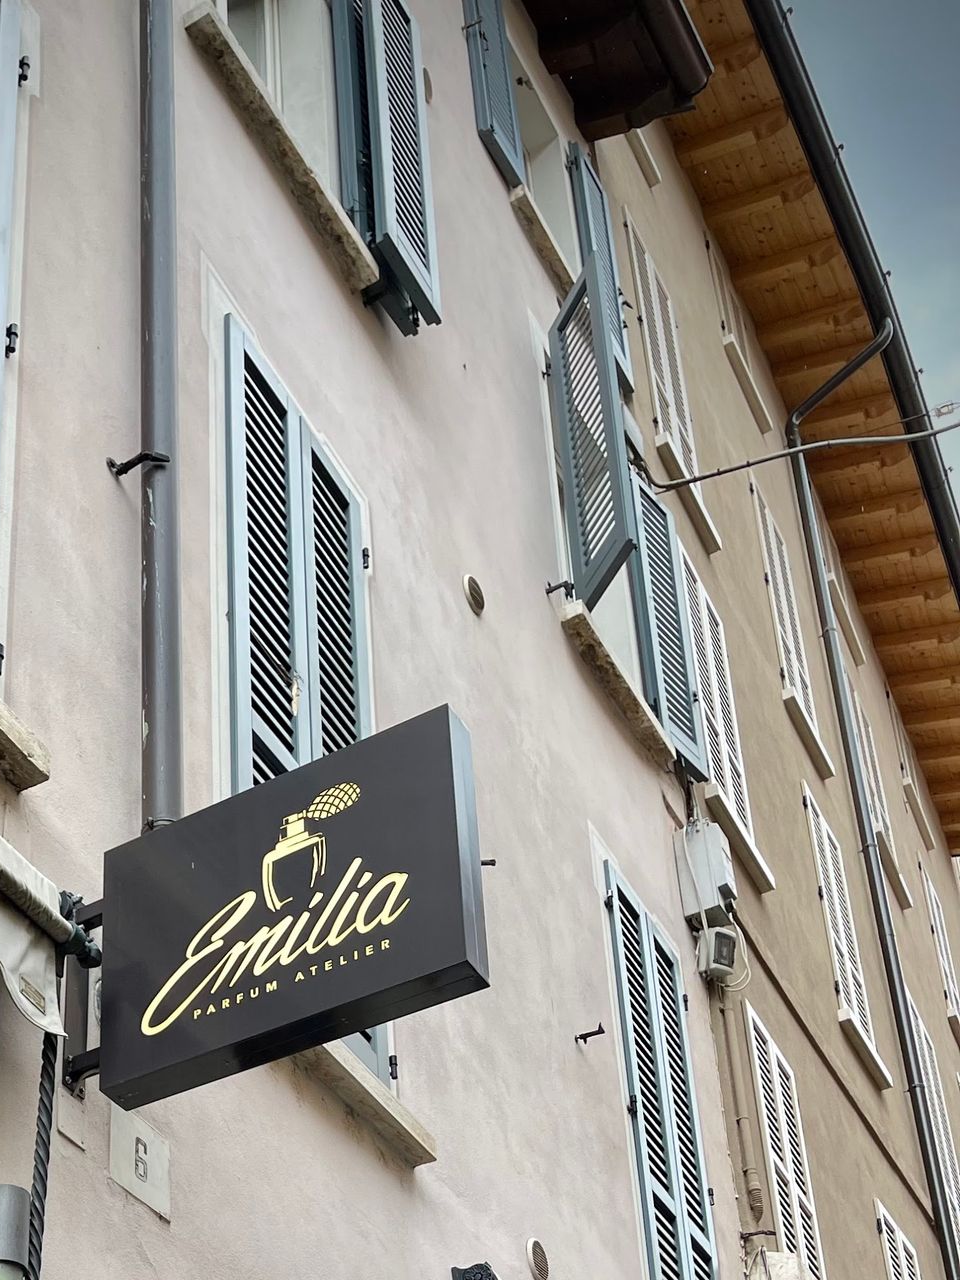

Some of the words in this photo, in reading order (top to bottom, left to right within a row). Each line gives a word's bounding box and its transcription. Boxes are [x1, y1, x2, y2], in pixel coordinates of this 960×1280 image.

[140, 857, 411, 1036] Emilia
[192, 980, 278, 1020] PARFUM
[294, 938, 391, 983] ATELIER
[135, 1136, 148, 1183] 6
